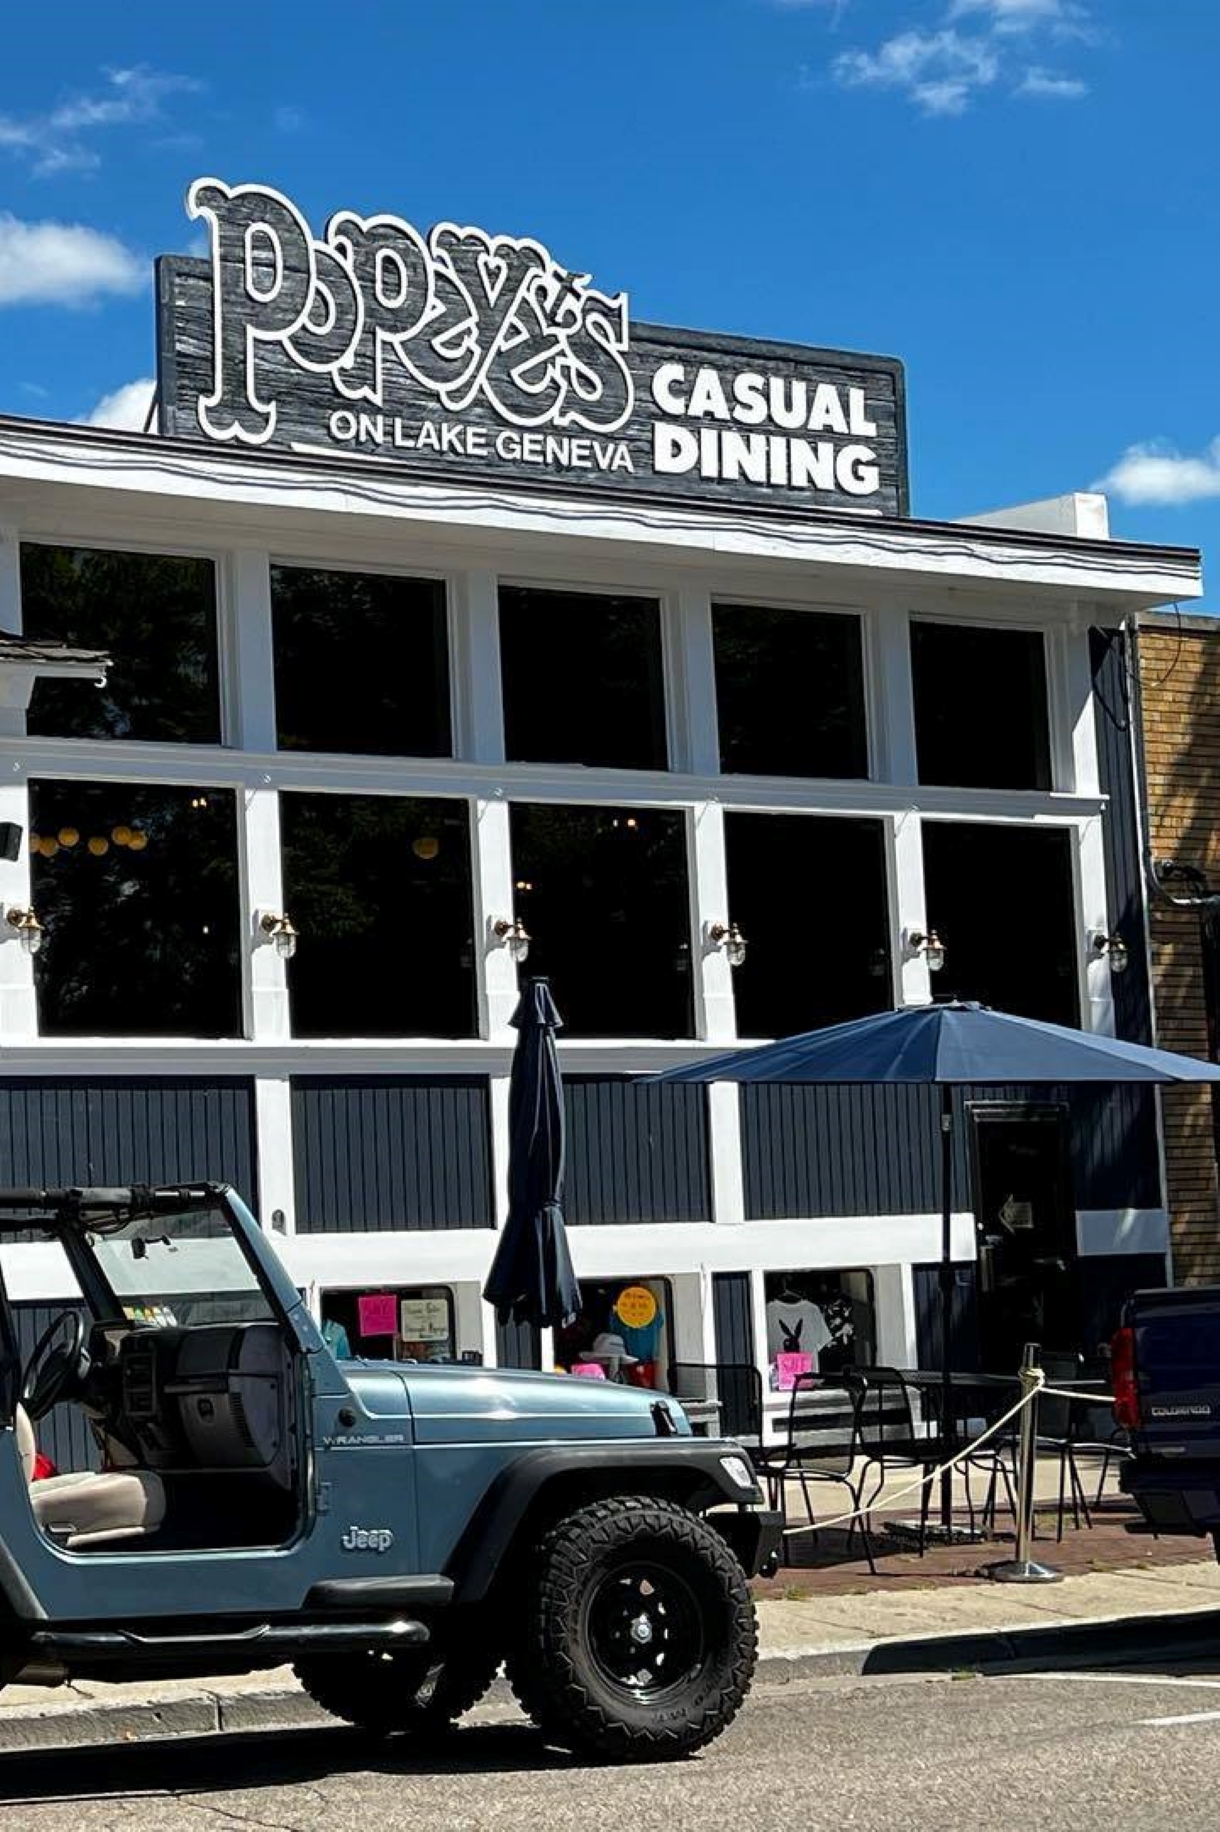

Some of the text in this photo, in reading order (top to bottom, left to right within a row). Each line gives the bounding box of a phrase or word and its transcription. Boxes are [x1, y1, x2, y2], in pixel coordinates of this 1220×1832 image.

[652, 363, 878, 438] CASUAL
[329, 410, 635, 474] ON LAKE GENEVA
[653, 423, 883, 496] DINING
[322, 1433, 405, 1446] WRANGLER
[341, 1525, 394, 1552] Jeep
